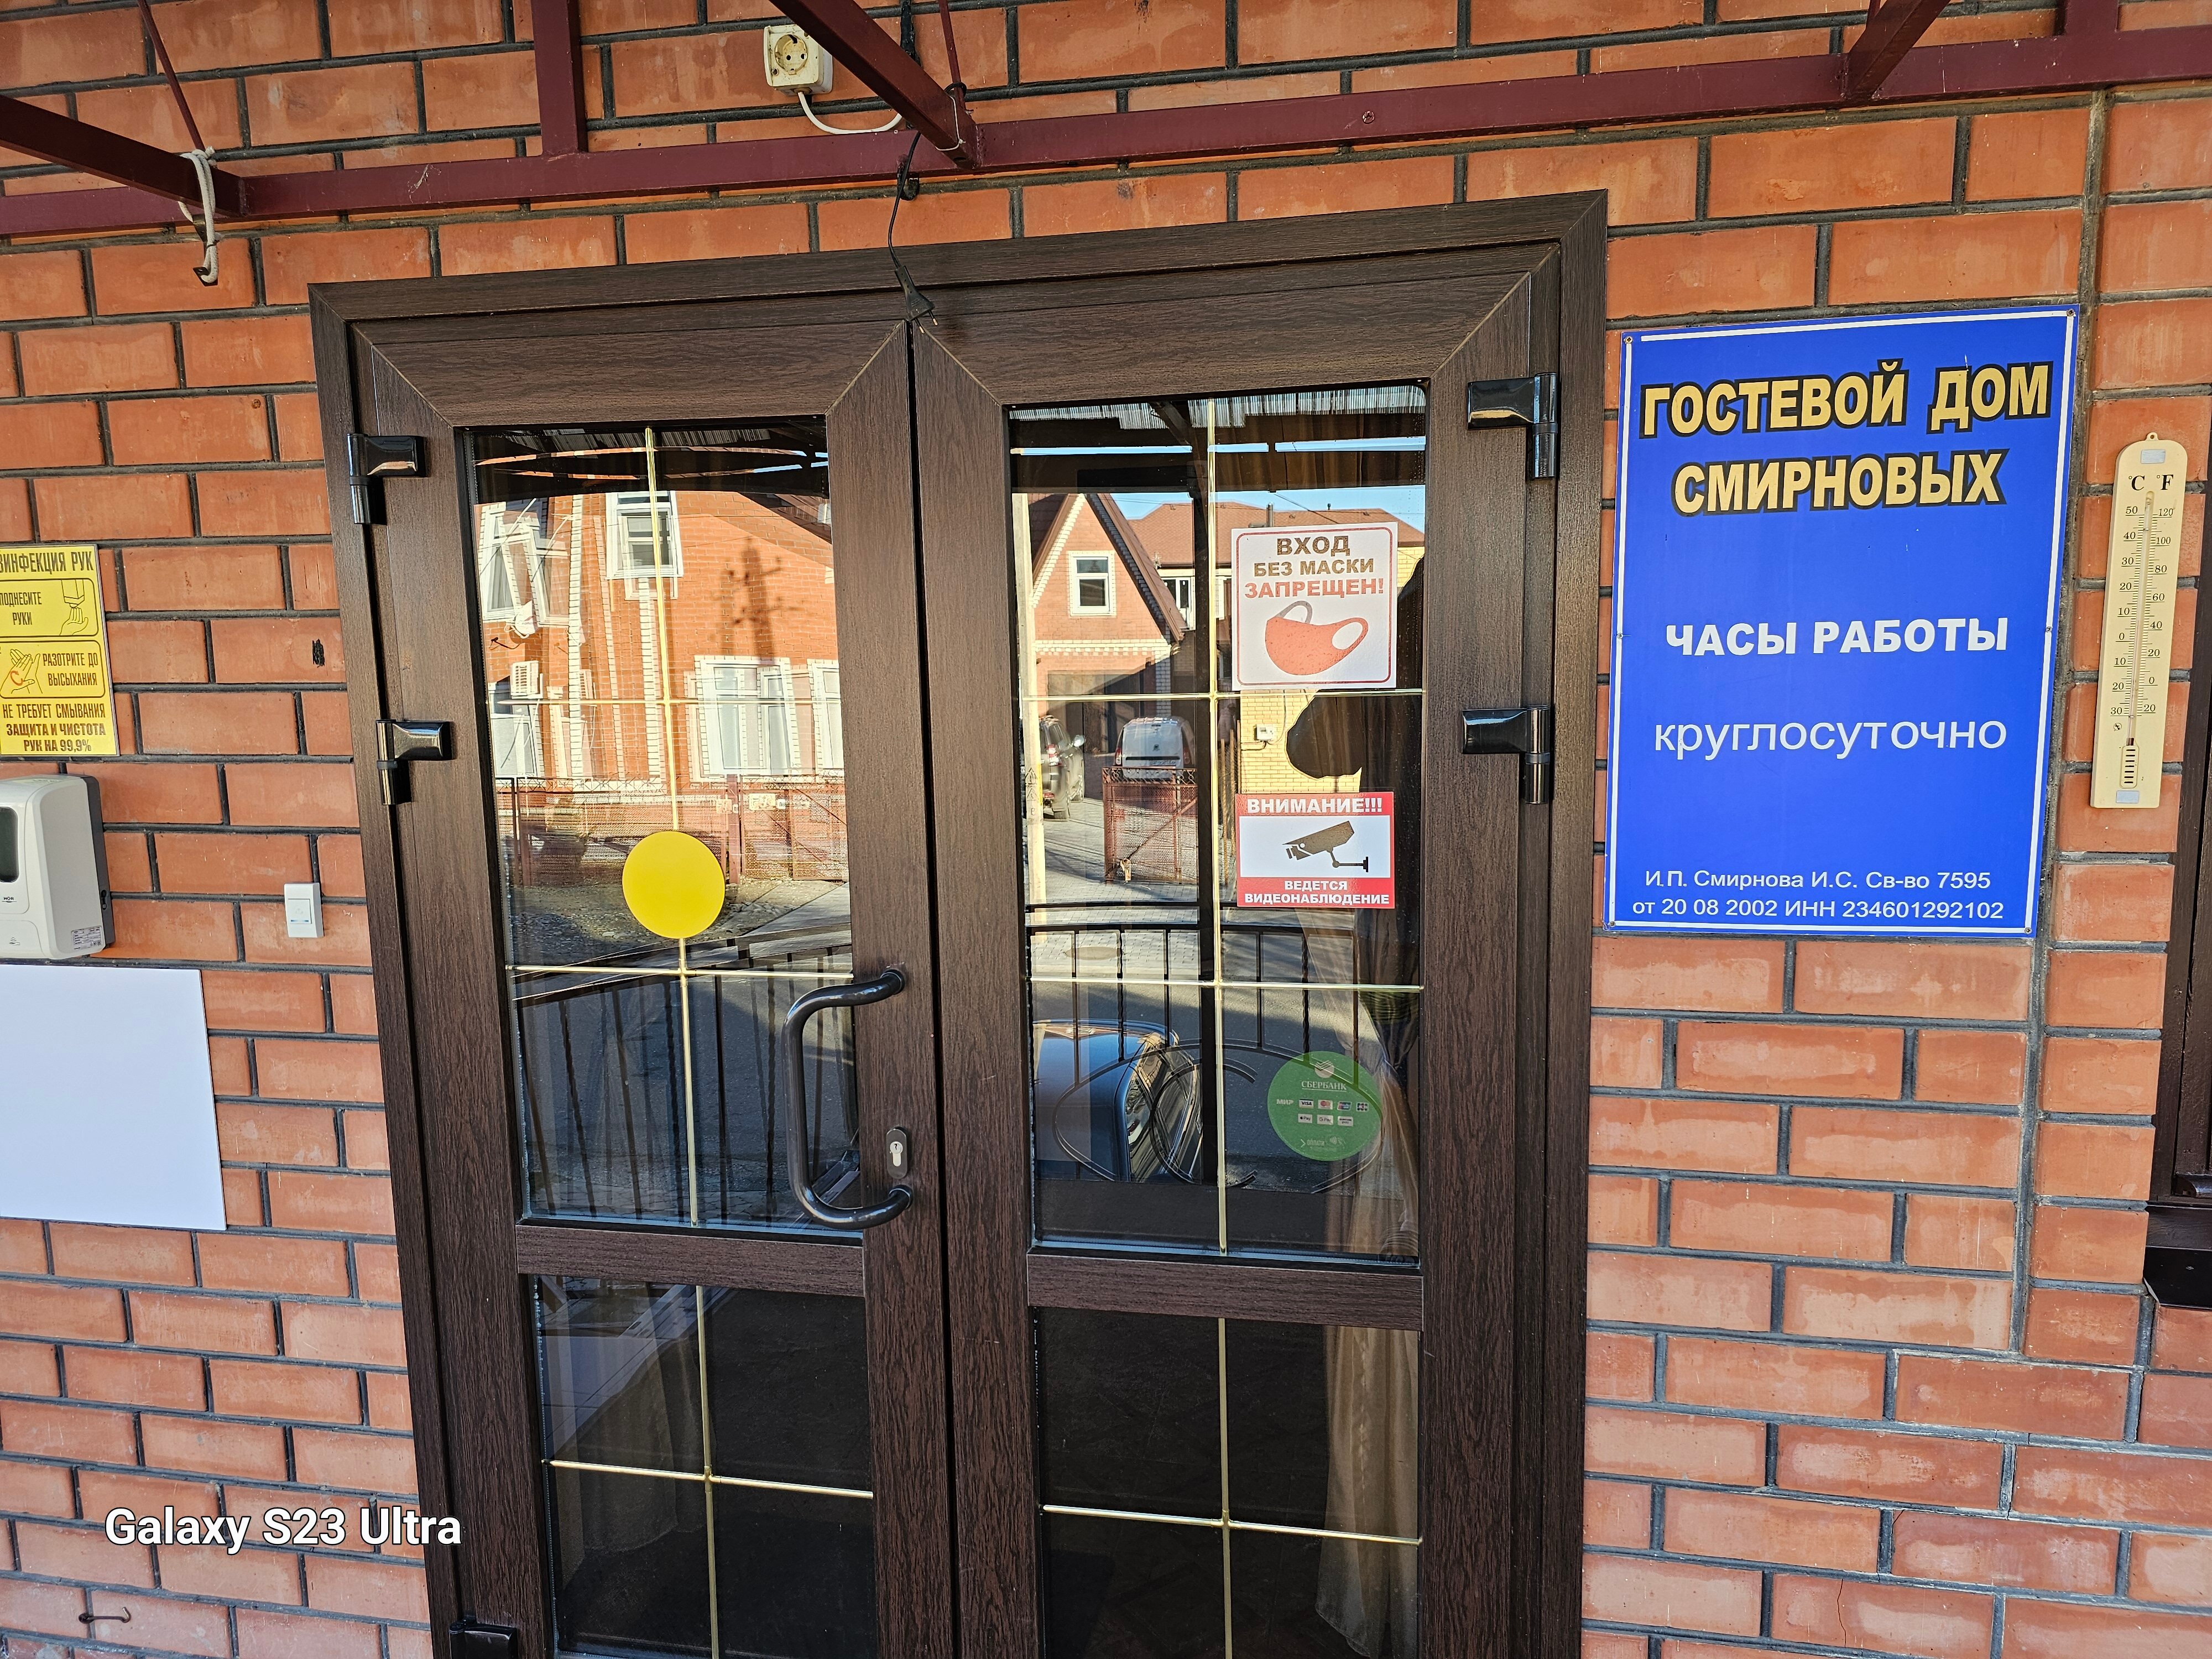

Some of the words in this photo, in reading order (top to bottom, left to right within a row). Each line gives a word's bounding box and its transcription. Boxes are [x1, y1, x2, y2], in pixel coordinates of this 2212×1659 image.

[1640, 358, 1910, 439] ГОСТЕВОЙ
[1928, 361, 2053, 434] ДОМ
[1672, 449, 2010, 517] СМИРНОВЫХ
[1277, 536, 1350, 556] ВХОД
[71, 551, 93, 572] РУК
[1254, 562, 1292, 576] БЕЗ
[1300, 559, 1374, 575] МАСКИ
[1245, 578, 1384, 598] ЗАПРЕЩЕН!
[0, 592, 42, 607] ПОДНЕСИТЕ
[12, 612, 32, 625] РУКИ
[1666, 622, 1796, 657] ЧАСЫ
[1813, 618, 2007, 654] РАБОТЫ
[43, 653, 85, 667] РАЗОТРИТЕ
[88, 653, 98, 667] ДО
[48, 672, 97, 686] ВЫСЫХАНИЯ
[3, 703, 13, 718] НЕ
[17, 703, 51, 718] ТРЕБУЕТ
[56, 703, 106, 718] СМЫВАНИЯ
[7, 723, 49, 738] ЗАЩИТА
[51, 723, 57, 735] И
[60, 722, 106, 735] ЧИСТОТА
[24, 739, 45, 752] РУК
[45, 739, 58, 751] НА
[60, 739, 91, 752] 99,9%
[1655, 721, 2007, 760] круглосуточно
[1247, 797, 1382, 813] ВНИМАНИЕ!!!
[1284, 880, 1347, 891] ВЕДЕТСЯ
[1694, 870, 1803, 890] Смирнова
[1811, 871, 1857, 889] И.С.
[1866, 872, 1929, 889] Св-во
[1937, 872, 1991, 889] 7595
[1245, 893, 1390, 905] ВИДЕОНАБЛЮДЕНИЕ
[1632, 901, 1655, 915] от
[1661, 899, 1687, 915] 20
[1693, 899, 1719, 916] 08
[1725, 900, 1777, 917] 2002
[1786, 901, 1835, 917] ИНН
[1842, 901, 2004, 919] 234601292102
[1301, 1081, 1347, 1090] СБЕРБАНК
